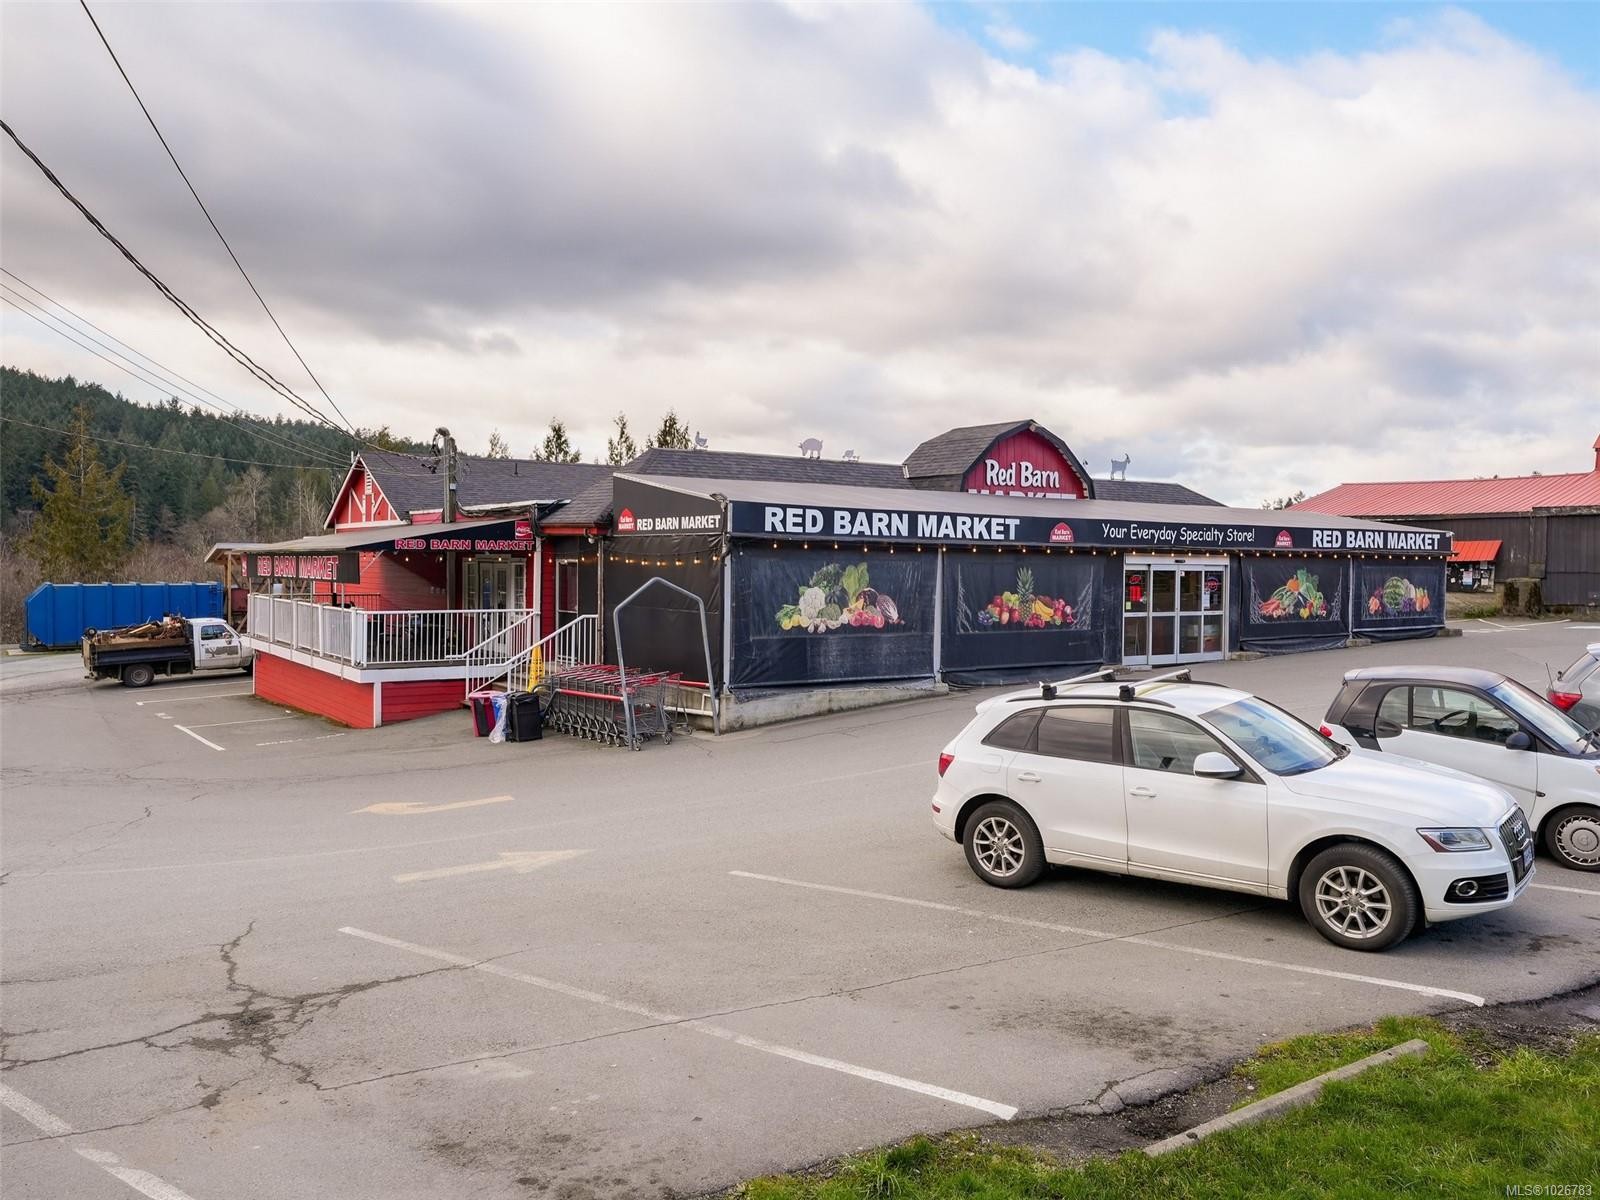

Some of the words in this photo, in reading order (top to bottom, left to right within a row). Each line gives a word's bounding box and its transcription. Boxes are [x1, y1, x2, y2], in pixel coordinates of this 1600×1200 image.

[985, 459, 1016, 486] Red
[1020, 461, 1060, 488] Barn
[636, 518, 653, 531] RED
[655, 517, 679, 530] BARN
[681, 514, 721, 529] MARKET
[764, 506, 824, 534] RED
[833, 510, 912, 537] BARN
[917, 513, 1021, 541] MARKET
[394, 539, 427, 550] RED
[430, 539, 472, 550] BARN
[475, 539, 535, 551] MARKET
[1102, 523, 1128, 538] Your
[1130, 524, 1177, 544] Everyday
[1179, 526, 1224, 545] Specialty
[1226, 528, 1255, 542] Store!
[1312, 529, 1342, 548] RED
[1346, 530, 1384, 549] BARN
[1387, 532, 1440, 550] MARKET
[257, 555, 272, 577] RED
[274, 555, 297, 578] BARN
[298, 555, 339, 580] MARKET
